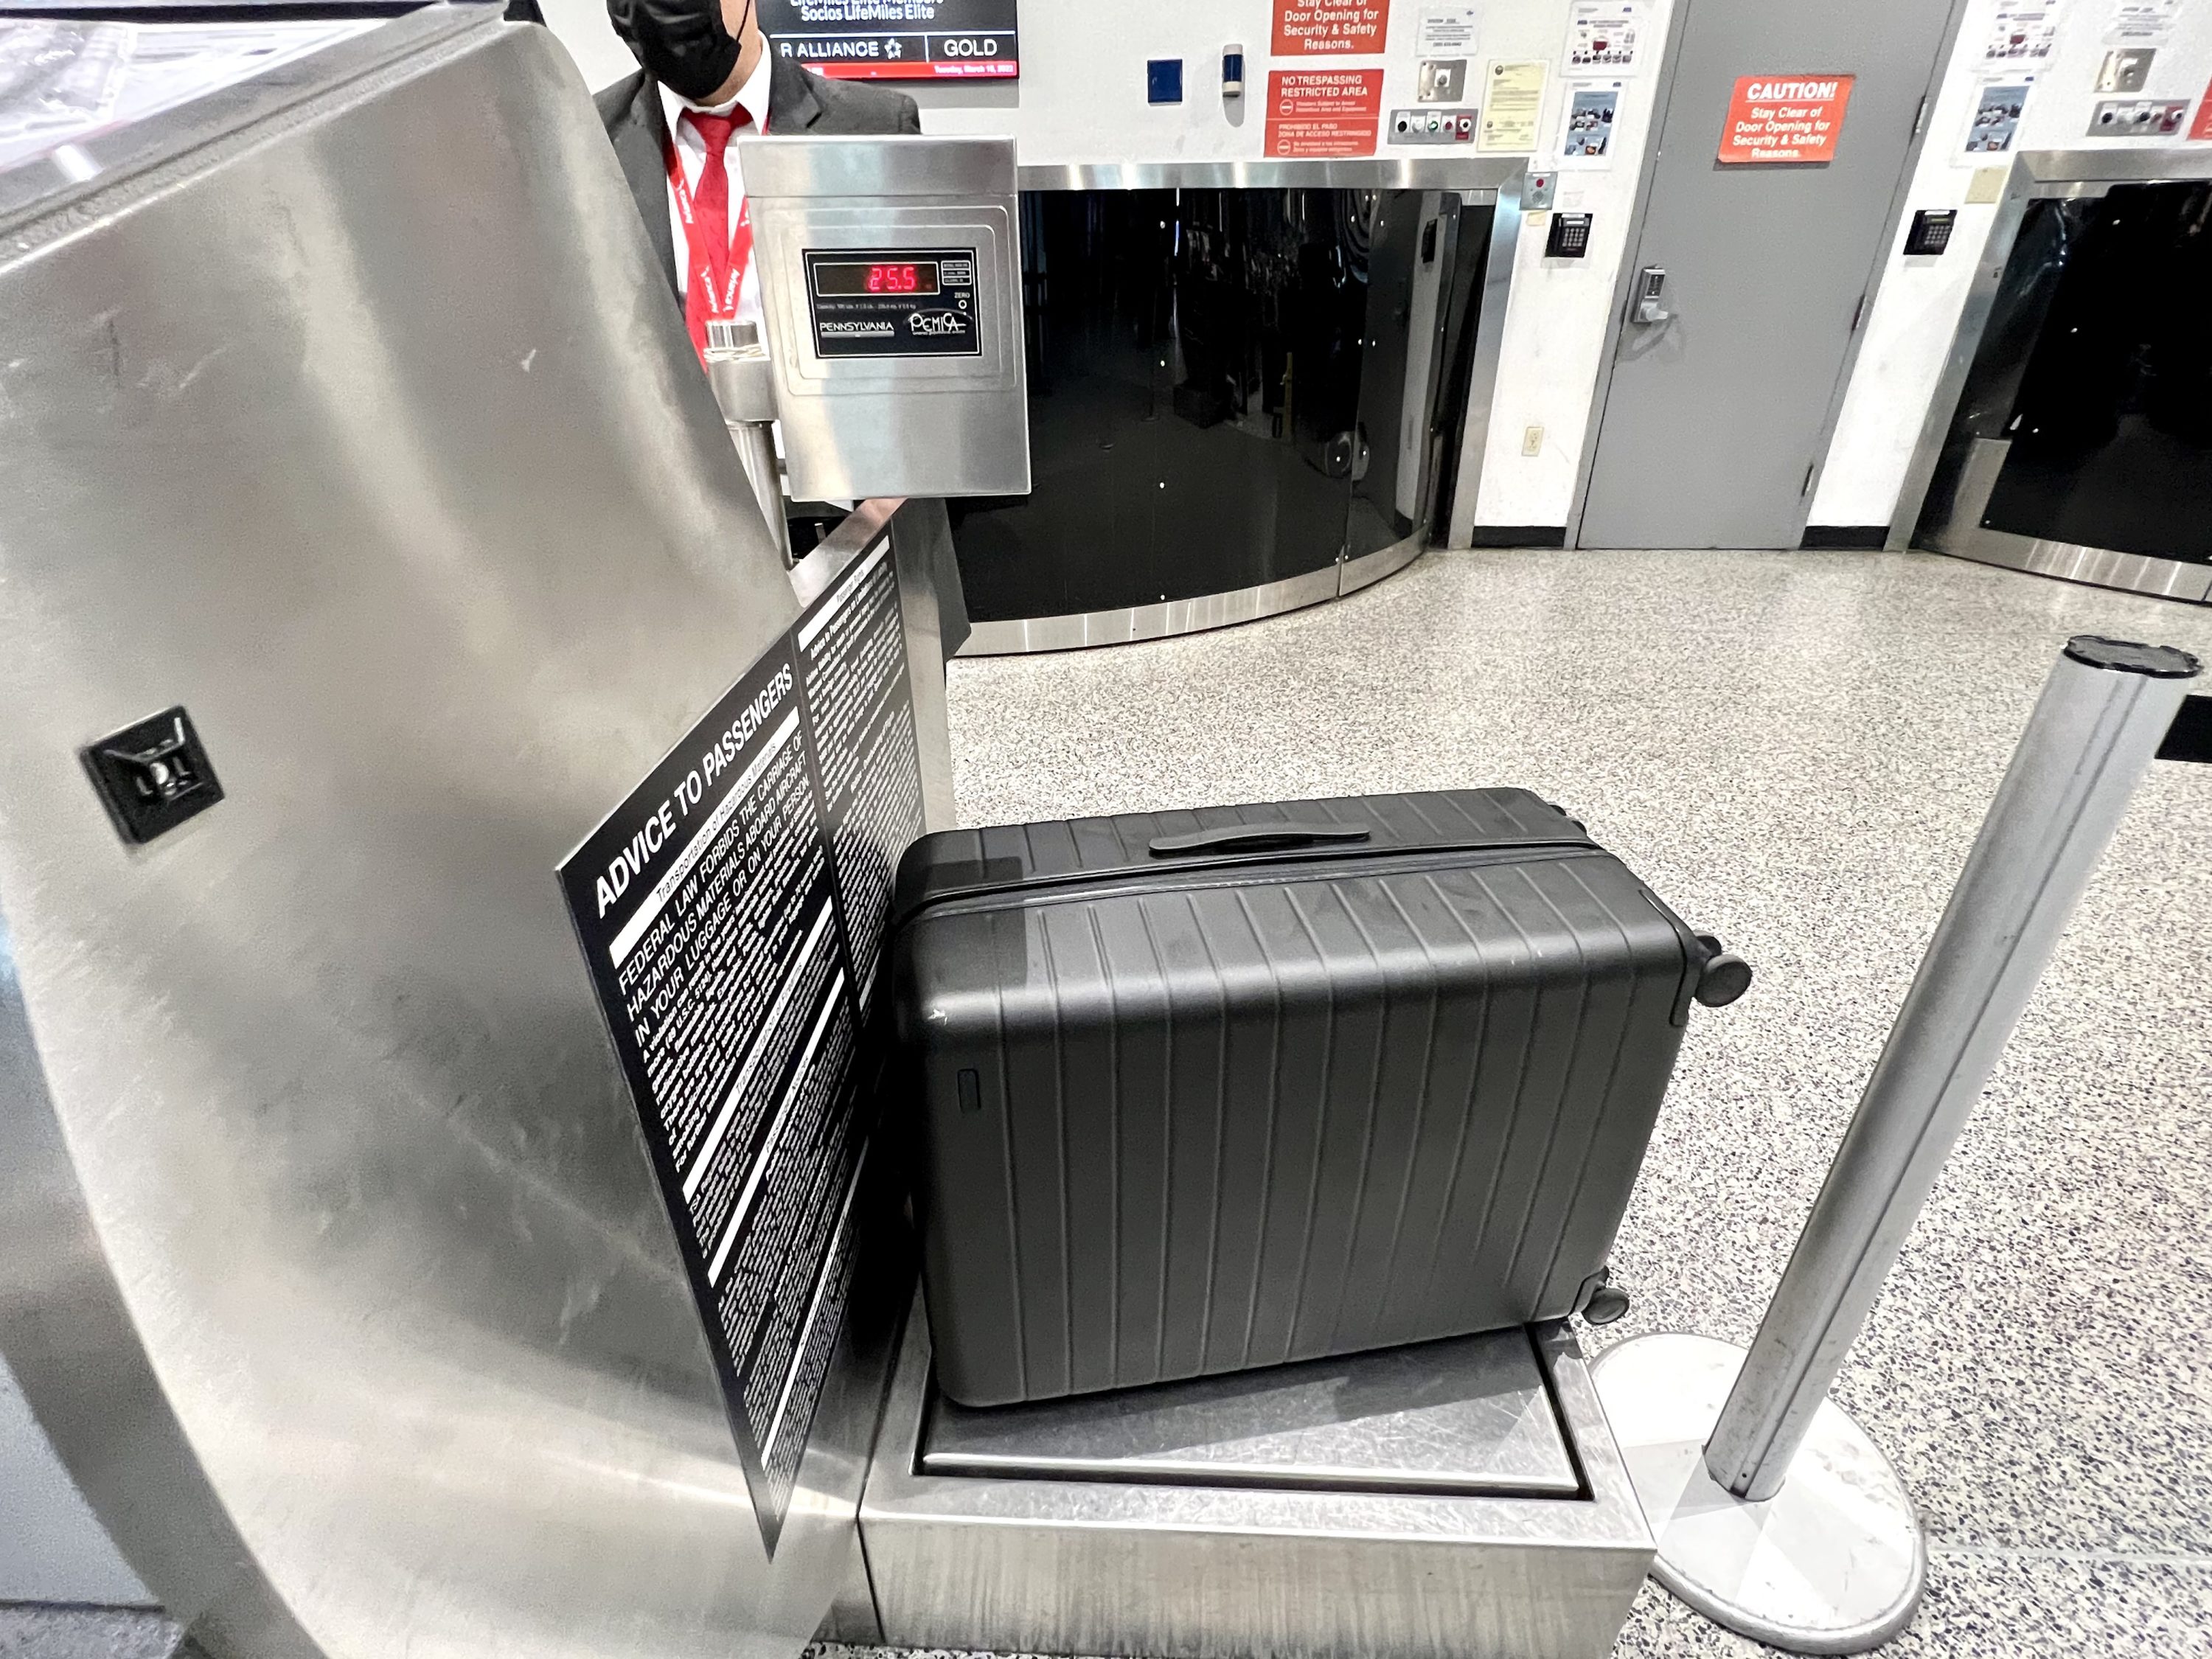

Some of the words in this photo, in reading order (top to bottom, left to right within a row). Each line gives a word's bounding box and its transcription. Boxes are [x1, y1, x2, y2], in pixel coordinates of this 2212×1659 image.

[801, 5, 843, 21] Socios
[844, 5, 903, 21] LifeMiles
[905, 4, 935, 20] Elite
[1284, 10, 1311, 22] Door
[1314, 9, 1360, 23] Opening
[1363, 8, 1379, 20] for
[1284, 24, 1329, 37] Security
[1332, 24, 1339, 35] &
[1343, 23, 1377, 37] Safety
[797, 42, 879, 58] ALLIANCE
[944, 39, 998, 57] GOLD
[1304, 38, 1354, 50] Reasons.
[1281, 76, 1295, 86] NO
[1298, 75, 1363, 86] TRESPASSING
[1281, 87, 1340, 97] RESTRICTED
[1341, 86, 1368, 96] AREA
[1747, 82, 1838, 100] CAUTION!
[1751, 108, 1775, 120] Stay
[1778, 107, 1808, 118] Clear
[1810, 106, 1823, 117] of
[1736, 121, 1764, 133] Door
[1765, 120, 1812, 133] Opening
[1815, 119, 1830, 131] for
[1733, 135, 1778, 147] Security
[1781, 134, 1789, 145] &
[1792, 133, 1826, 146] Safety
[869, 266, 917, 290] 25.5
[820, 322, 894, 331] PENNSYLVANIA
[597, 799, 677, 919] ADVICE
[673, 770, 703, 816] TO
[702, 663, 793, 787] PASSENGERS
[655, 828, 710, 902] Transportation
[711, 812, 720, 832] of
[720, 774, 751, 821] Hazardous
[618, 906, 675, 997] FEDERAL
[675, 872, 699, 919] LAW
[699, 816, 740, 885] FORBIDS
[739, 792, 757, 829] THE
[757, 742, 793, 804] CARRIAGE
[792, 728, 803, 755] OF
[626, 912, 697, 1022] HAZARDOUS
[695, 841, 745, 921] MATERIALS
[745, 796, 776, 851] ABOARD
[776, 750, 807, 806] AIRCRAFT
[635, 1017, 650, 1048] IN
[650, 966, 684, 1020] YOUR
[685, 891, 732, 971] LUGGAGE
[732, 869, 747, 897] OR
[748, 846, 761, 874] ON
[760, 815, 782, 852] YOUR
[782, 773, 810, 821] PERSON.
